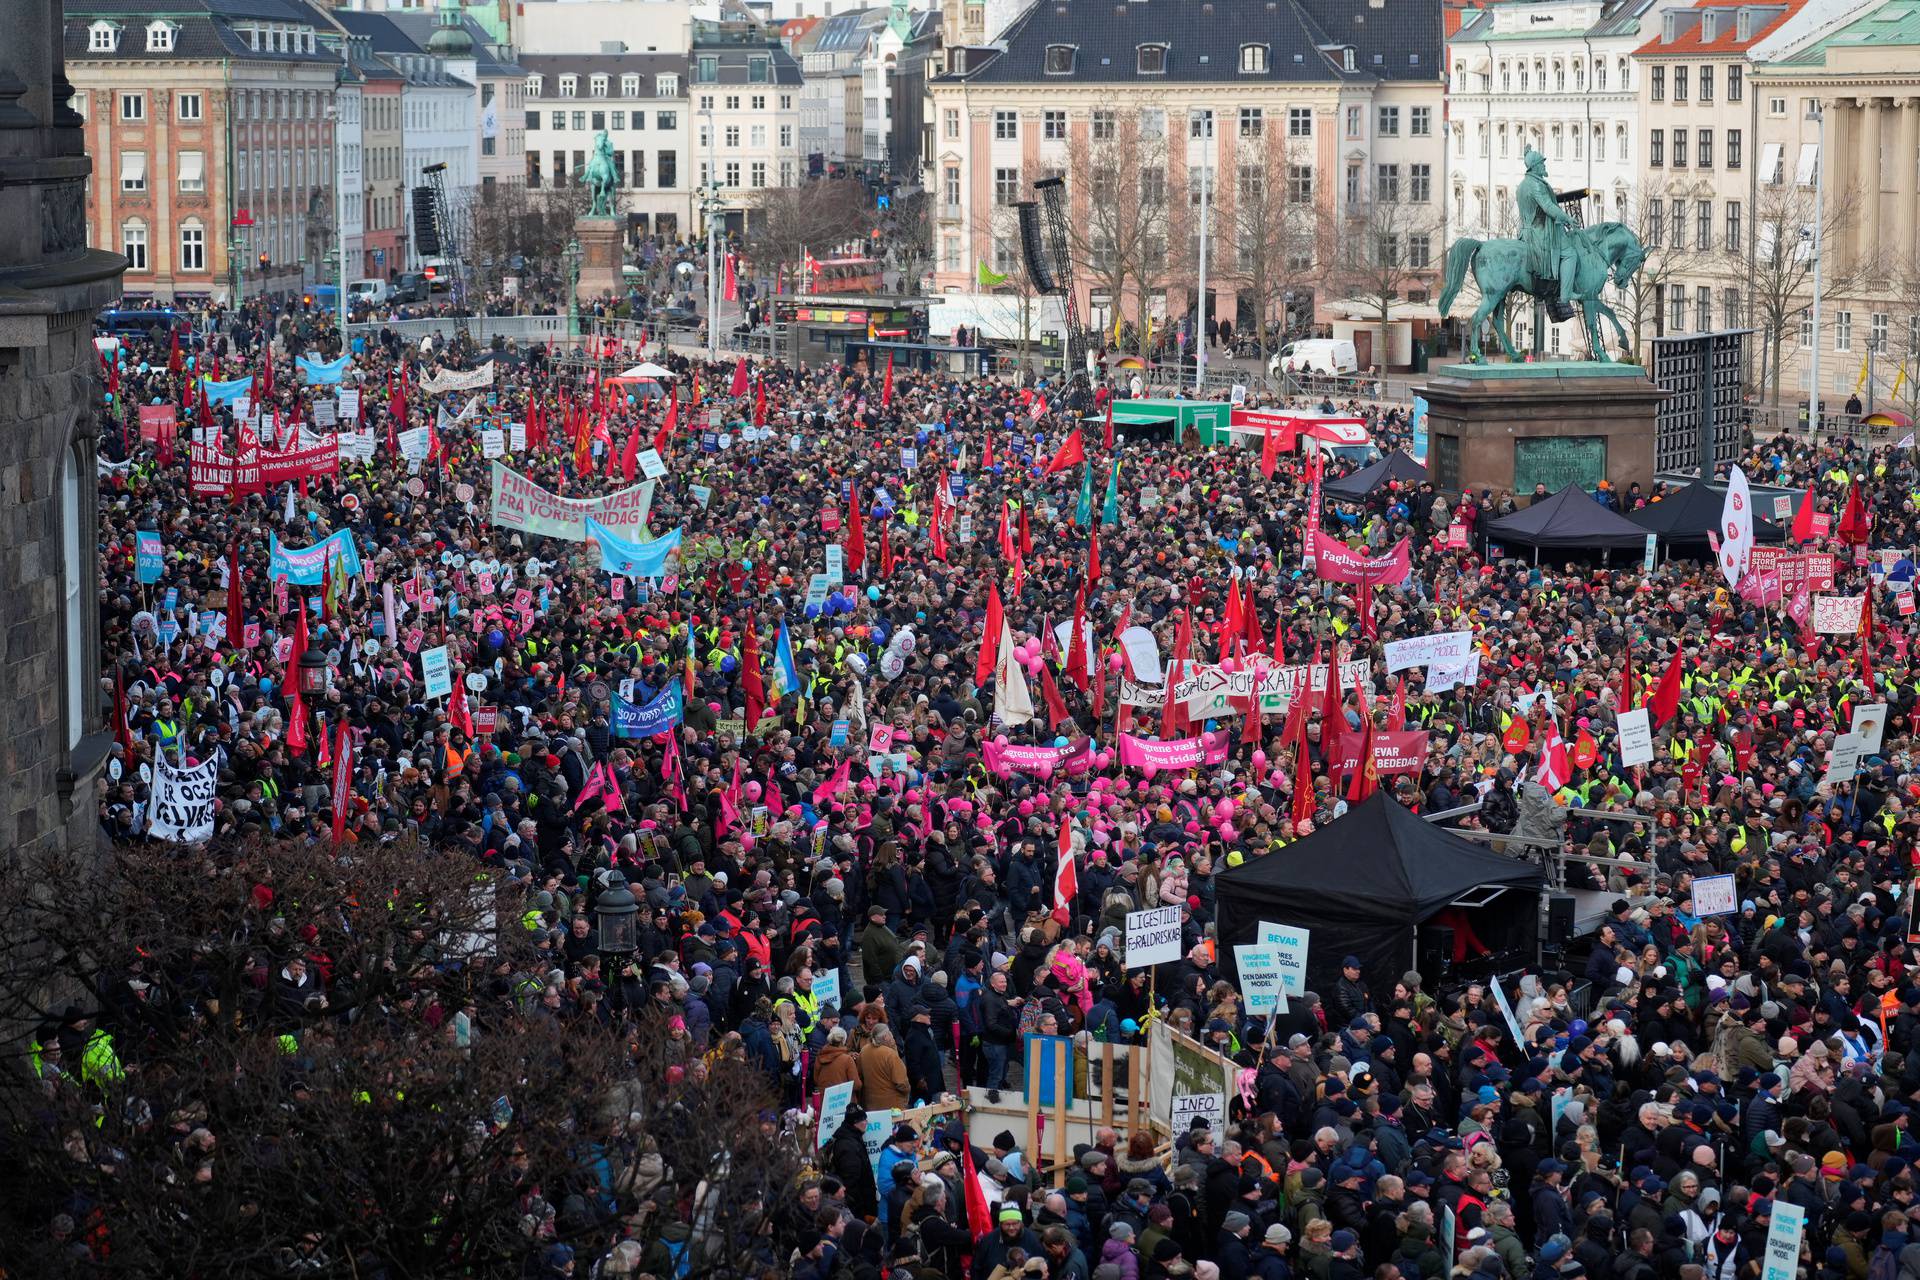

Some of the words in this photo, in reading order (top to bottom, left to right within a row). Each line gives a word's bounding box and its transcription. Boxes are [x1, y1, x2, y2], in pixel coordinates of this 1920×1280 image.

[191, 445, 204, 462] VIL
[502, 472, 594, 512] FINGRENE
[602, 489, 642, 510] VÆK
[499, 492, 524, 512] FRA
[530, 501, 579, 523] VORES
[586, 510, 638, 526] RIDAG
[1322, 550, 1362, 568] Faglige
[619, 562, 632, 571] 3F
[1434, 645, 1460, 657] MODEL
[617, 708, 637, 722] Stop
[638, 708, 660, 721] NATO
[661, 697, 676, 712] EU
[1036, 750, 1059, 758] væk
[1060, 746, 1076, 755] fra
[1133, 740, 1171, 753] Fingrene
[1173, 740, 1196, 751] væk
[1373, 747, 1399, 757] EVAR
[1145, 753, 1168, 764] vores
[1170, 751, 1205, 763] fridag!
[1376, 757, 1418, 769] BEDEDAG
[1129, 905, 1181, 930] LIGESTILLET
[1268, 934, 1298, 947] BEVAR
[1243, 973, 1255, 981] DEN
[1179, 1096, 1215, 1111] INFO
